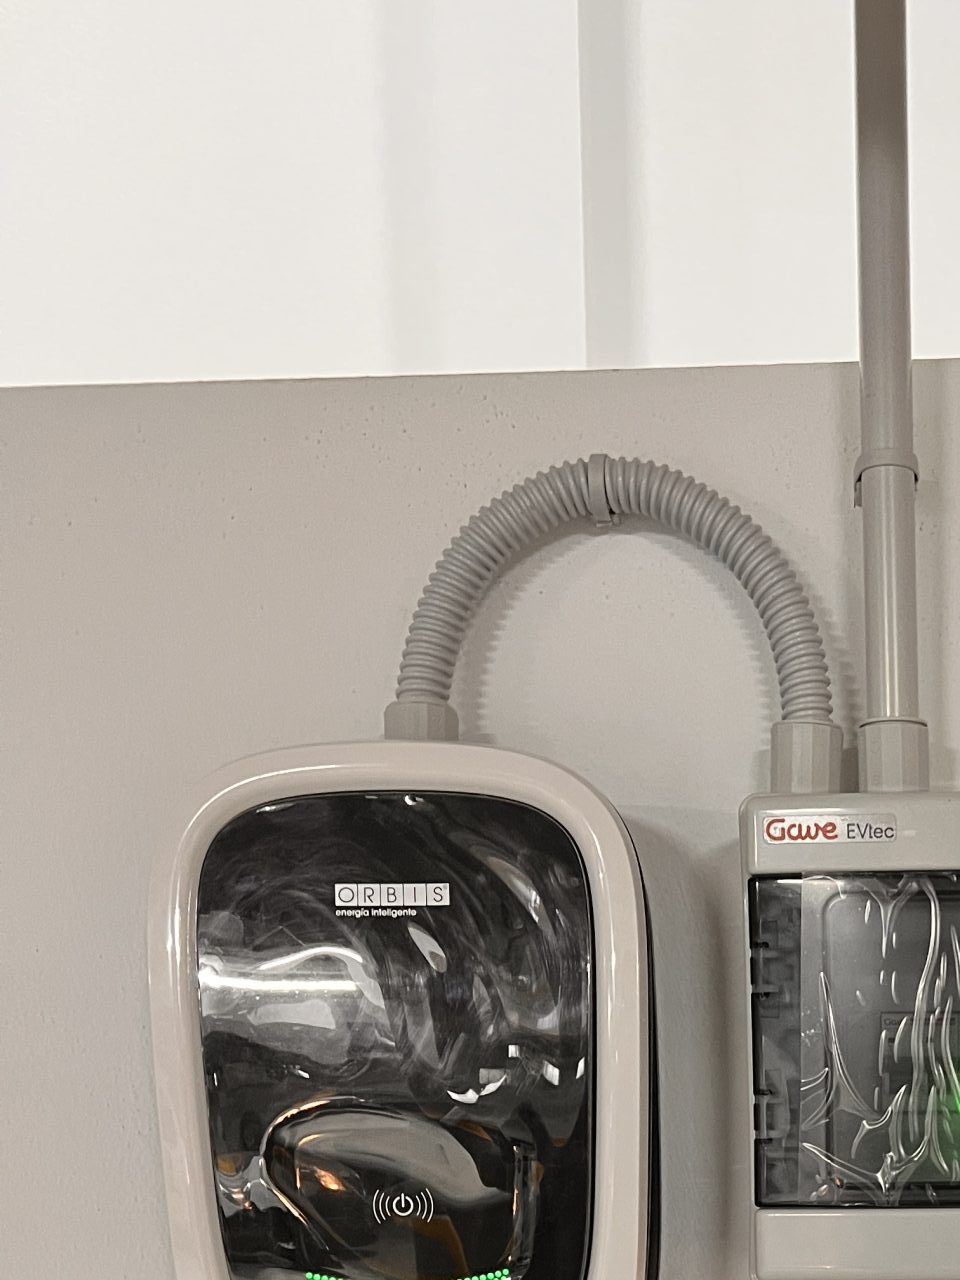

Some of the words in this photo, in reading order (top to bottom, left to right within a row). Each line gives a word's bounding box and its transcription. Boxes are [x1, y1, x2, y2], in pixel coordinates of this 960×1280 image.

[765, 818, 839, 841] Gave
[846, 823, 895, 839] EVtec
[338, 886, 444, 903] ORBIS
[371, 907, 417, 918] inteligente
